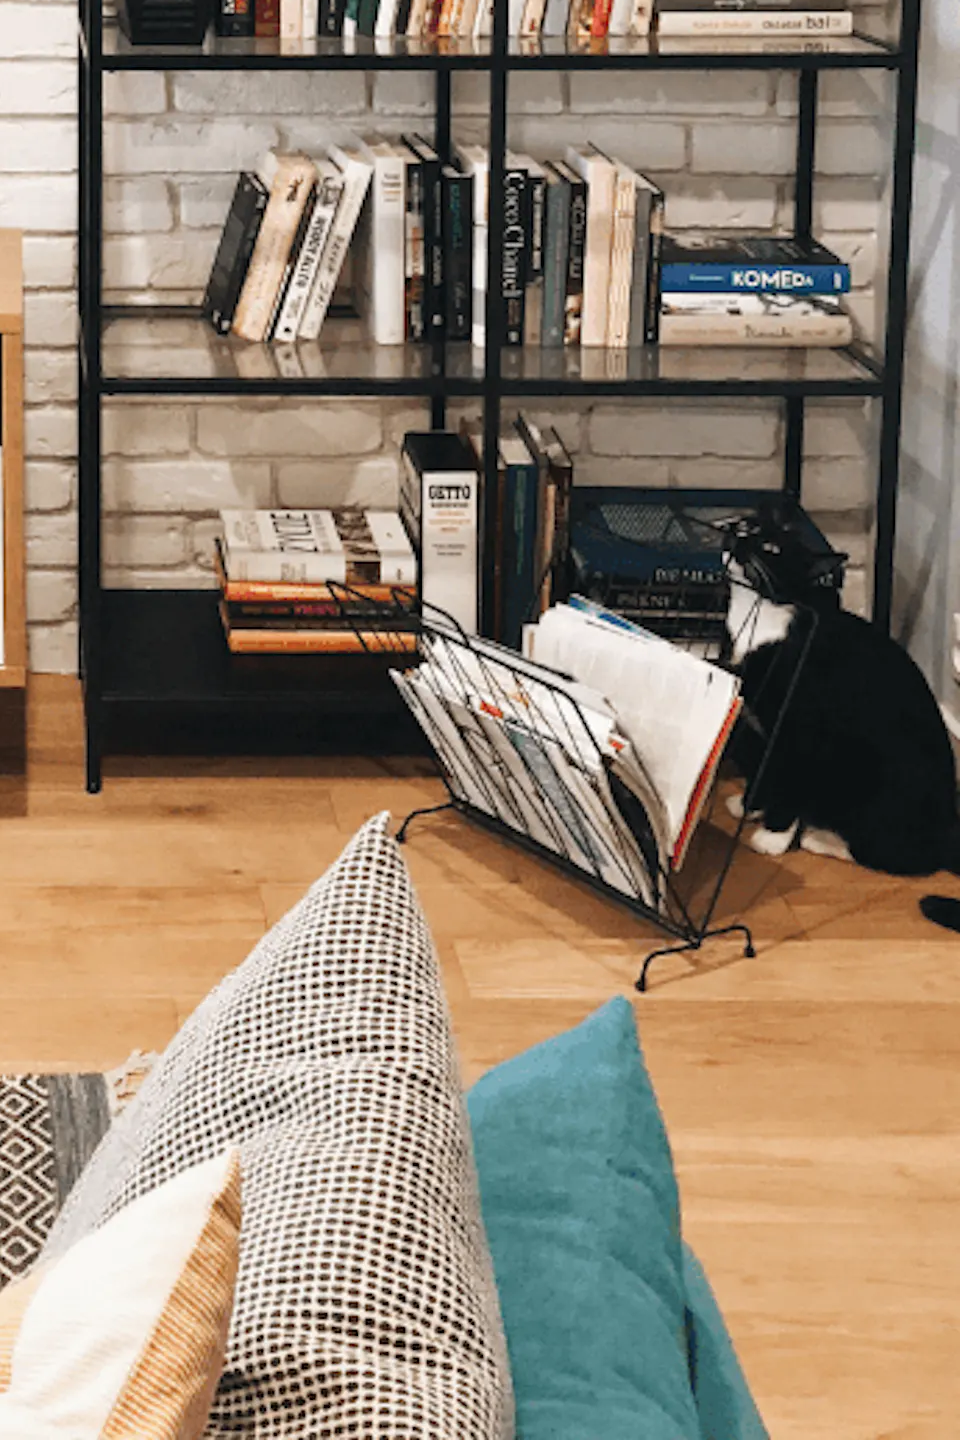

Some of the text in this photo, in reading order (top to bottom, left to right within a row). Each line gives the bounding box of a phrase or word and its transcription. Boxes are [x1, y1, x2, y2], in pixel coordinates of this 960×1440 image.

[501, 171, 525, 298] Coco Chanel
[731, 269, 815, 290] KOMEDA
